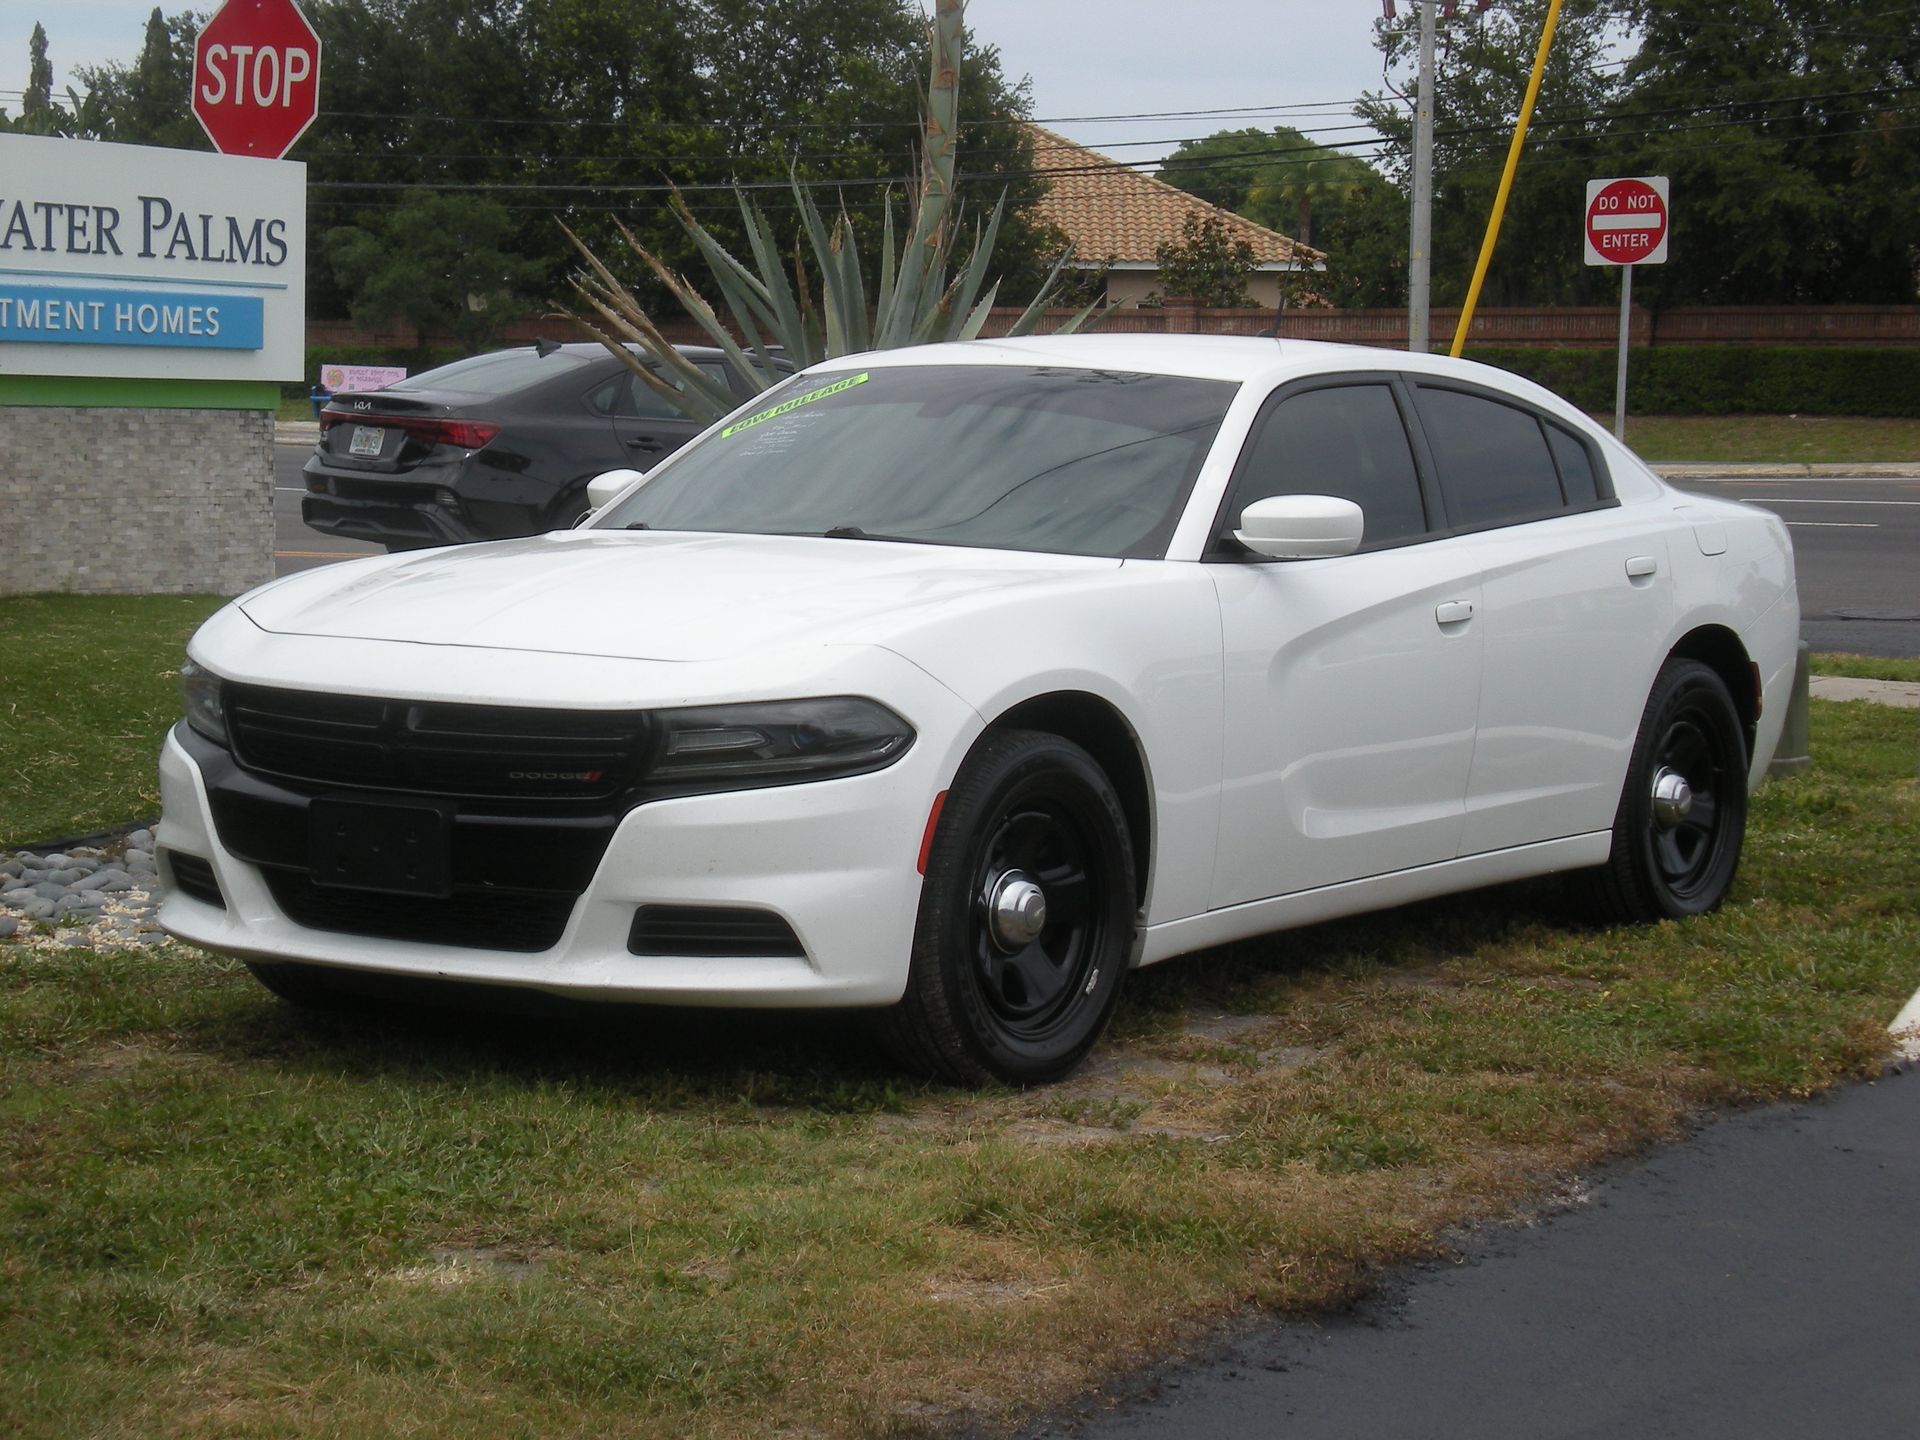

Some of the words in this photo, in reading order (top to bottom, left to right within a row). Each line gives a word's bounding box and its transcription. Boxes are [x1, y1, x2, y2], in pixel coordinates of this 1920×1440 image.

[201, 43, 311, 108] STOP
[1599, 196, 1619, 210] DO
[1627, 194, 1656, 209] NOT
[0, 198, 124, 256] ATER
[1602, 233, 1649, 248] ENTER
[115, 302, 220, 336] HOMES
[354, 401, 371, 410] KIA
[730, 410, 773, 434] LOW
[774, 376, 861, 415] MILEAGE
[509, 771, 591, 780] DODGE
